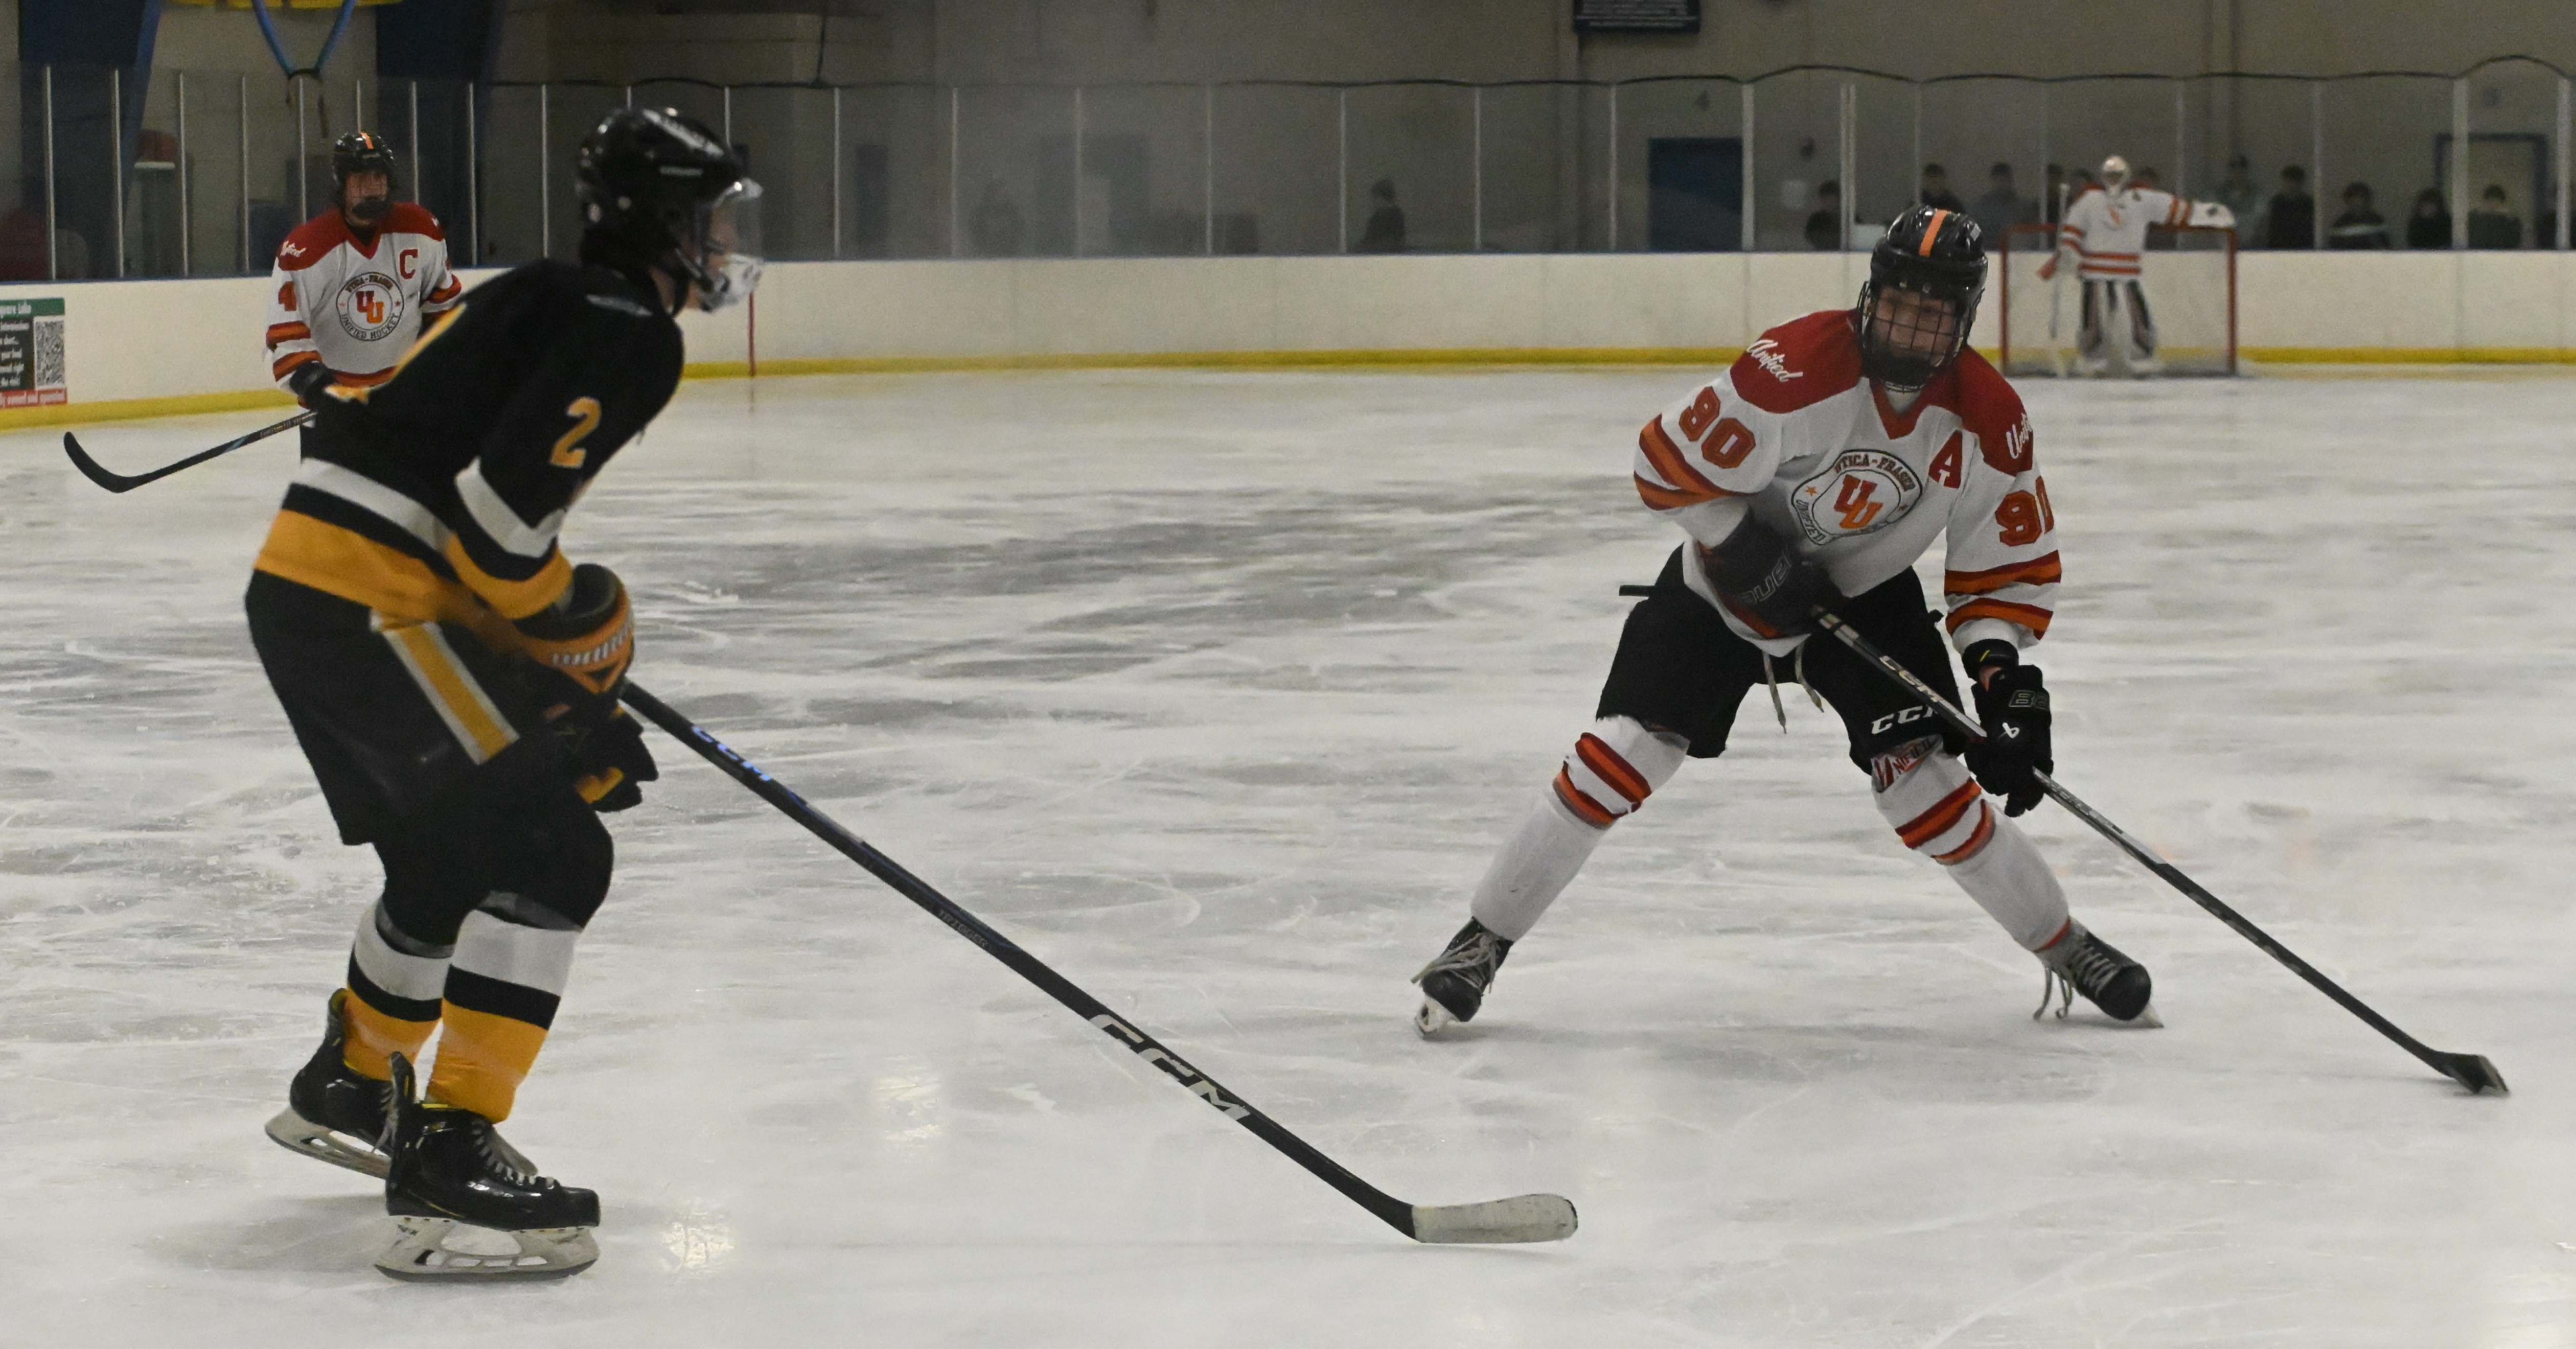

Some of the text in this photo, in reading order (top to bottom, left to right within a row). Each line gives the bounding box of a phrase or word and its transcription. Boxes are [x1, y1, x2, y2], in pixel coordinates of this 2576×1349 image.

[400, 249, 418, 279] C
[549, 396, 603, 469] 2
[1679, 386, 1756, 469] 90
[1928, 429, 1963, 489] A
[1994, 476, 2055, 547] 90
[1089, 1013, 1251, 1121] CCM
